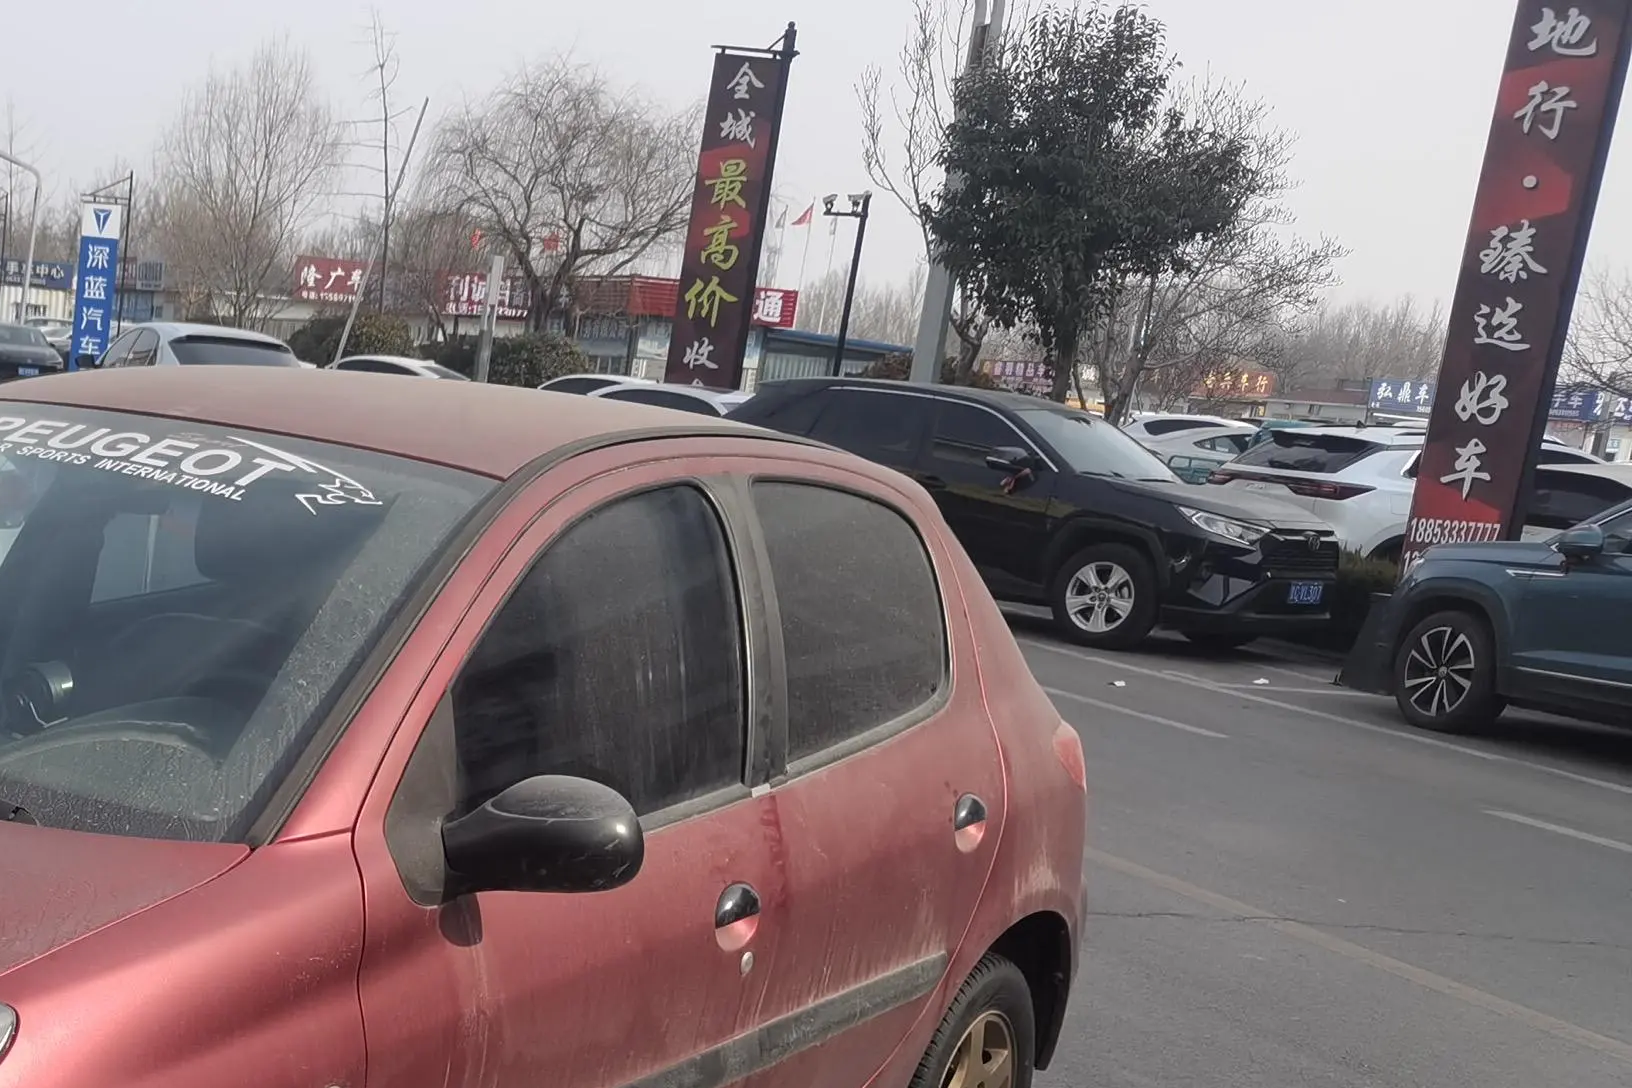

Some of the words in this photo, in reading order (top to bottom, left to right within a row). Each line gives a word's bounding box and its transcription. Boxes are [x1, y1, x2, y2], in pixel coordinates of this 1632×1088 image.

[682, 61, 765, 386] 全城最高价收
[78, 243, 110, 356] 深蓝汽车
[753, 291, 783, 323] 通
[16, 445, 91, 465] SPORTS
[94, 457, 246, 501] INTERNATIONAL
[1410, 518, 1501, 545] 18853337777
